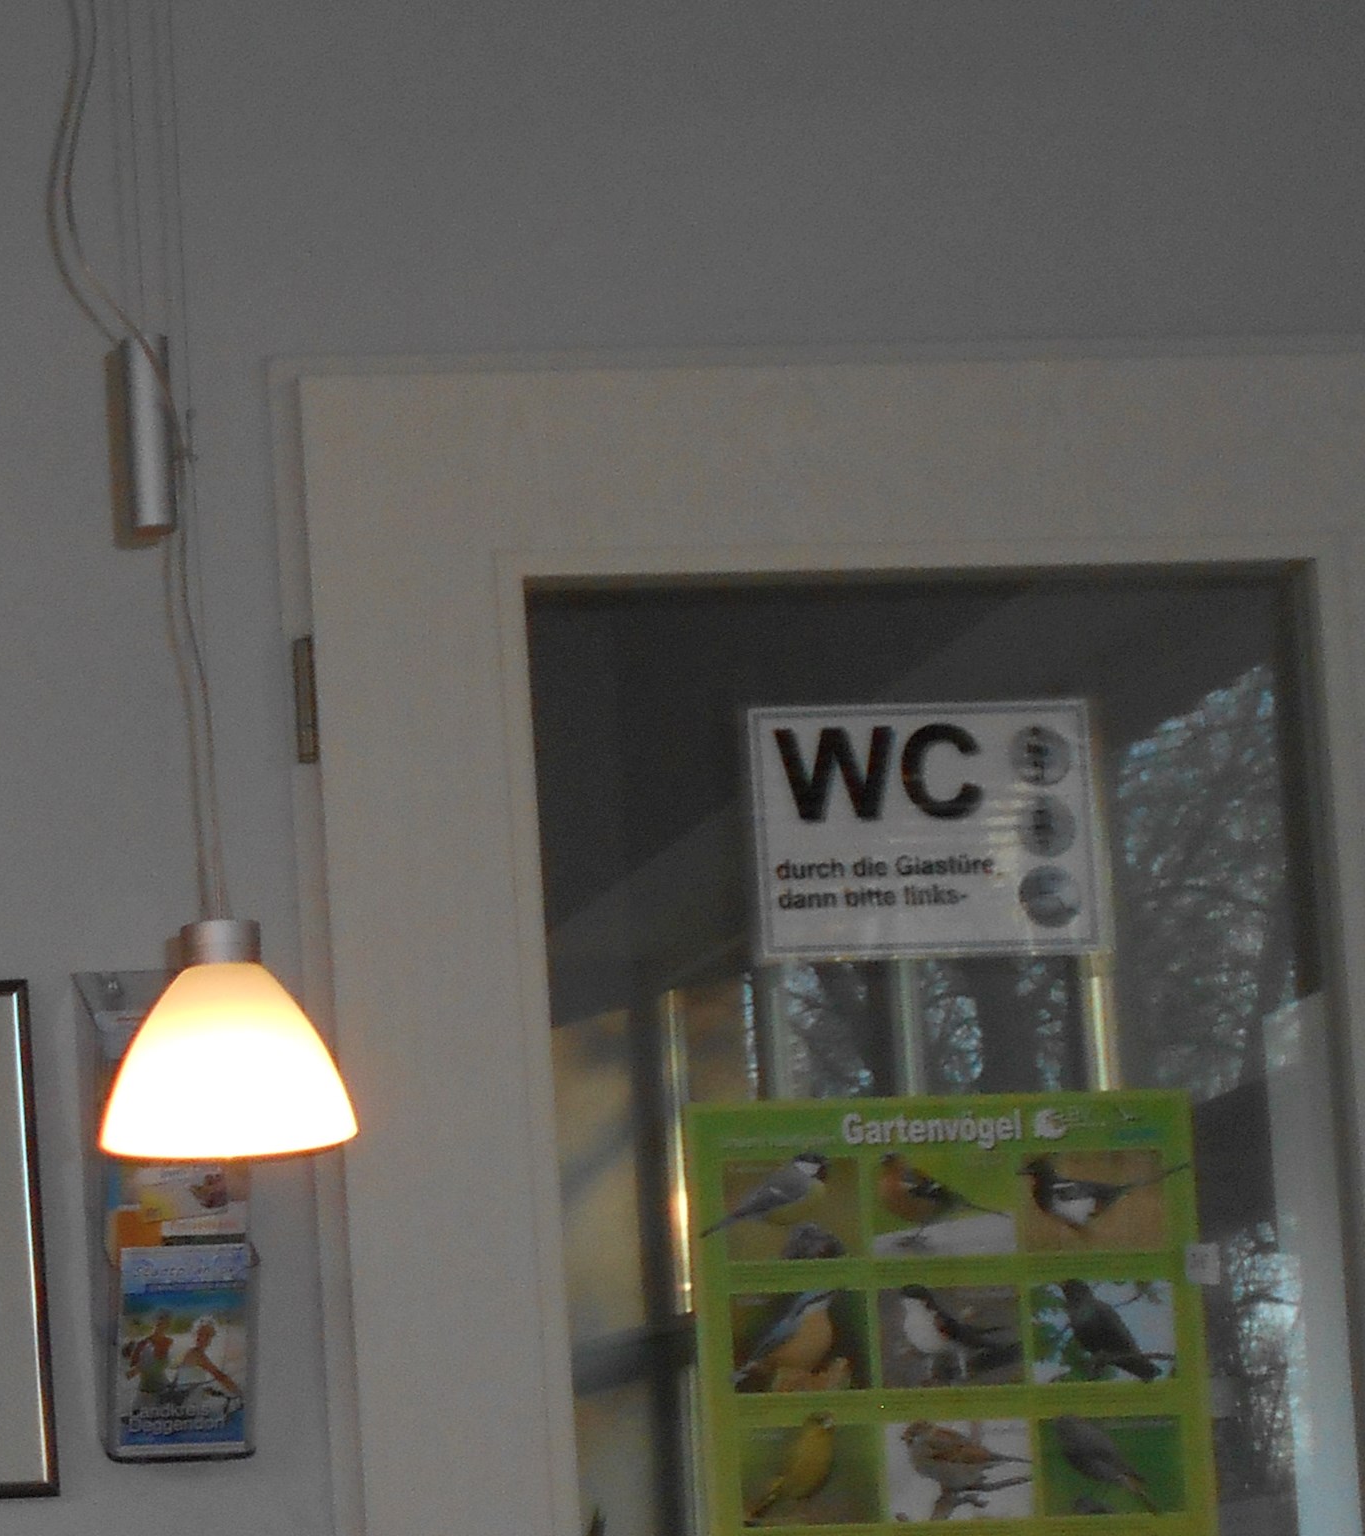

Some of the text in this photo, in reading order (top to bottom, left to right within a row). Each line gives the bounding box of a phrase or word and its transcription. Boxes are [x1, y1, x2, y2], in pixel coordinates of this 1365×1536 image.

[772, 723, 983, 823] WC
[776, 859, 845, 880] durch
[852, 857, 888, 877] die
[778, 888, 837, 910] dann
[842, 886, 896, 908] bitte
[841, 1109, 1022, 1150] Gartenvögel
